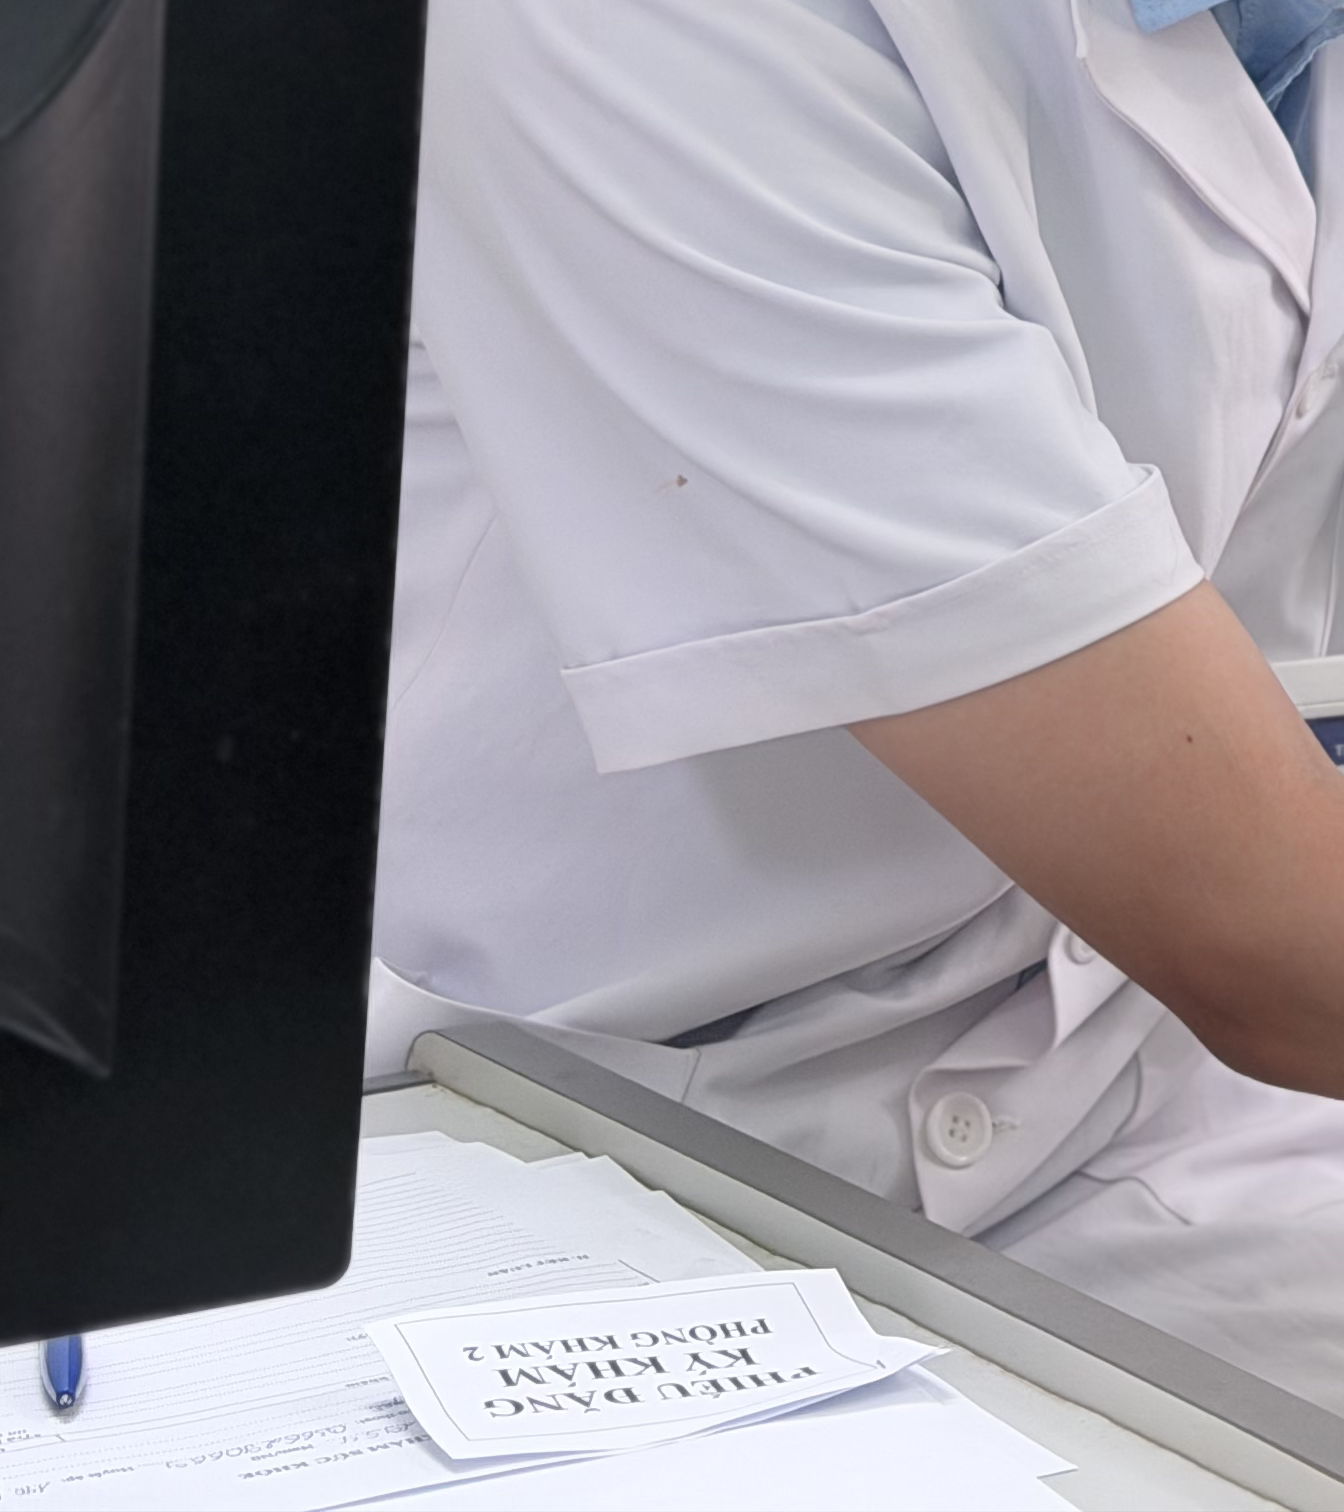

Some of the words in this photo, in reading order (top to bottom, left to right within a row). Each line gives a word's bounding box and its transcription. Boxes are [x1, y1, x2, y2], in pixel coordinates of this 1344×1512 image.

[630, 1317, 774, 1347] PHÒNG
[462, 1345, 485, 1362] 2
[491, 1334, 622, 1361] KHÁM
[685, 1347, 760, 1376] KÝ
[494, 1355, 670, 1388] KHÁM
[657, 1366, 820, 1400] PHIẾU
[484, 1386, 645, 1418] ĐĂNG
